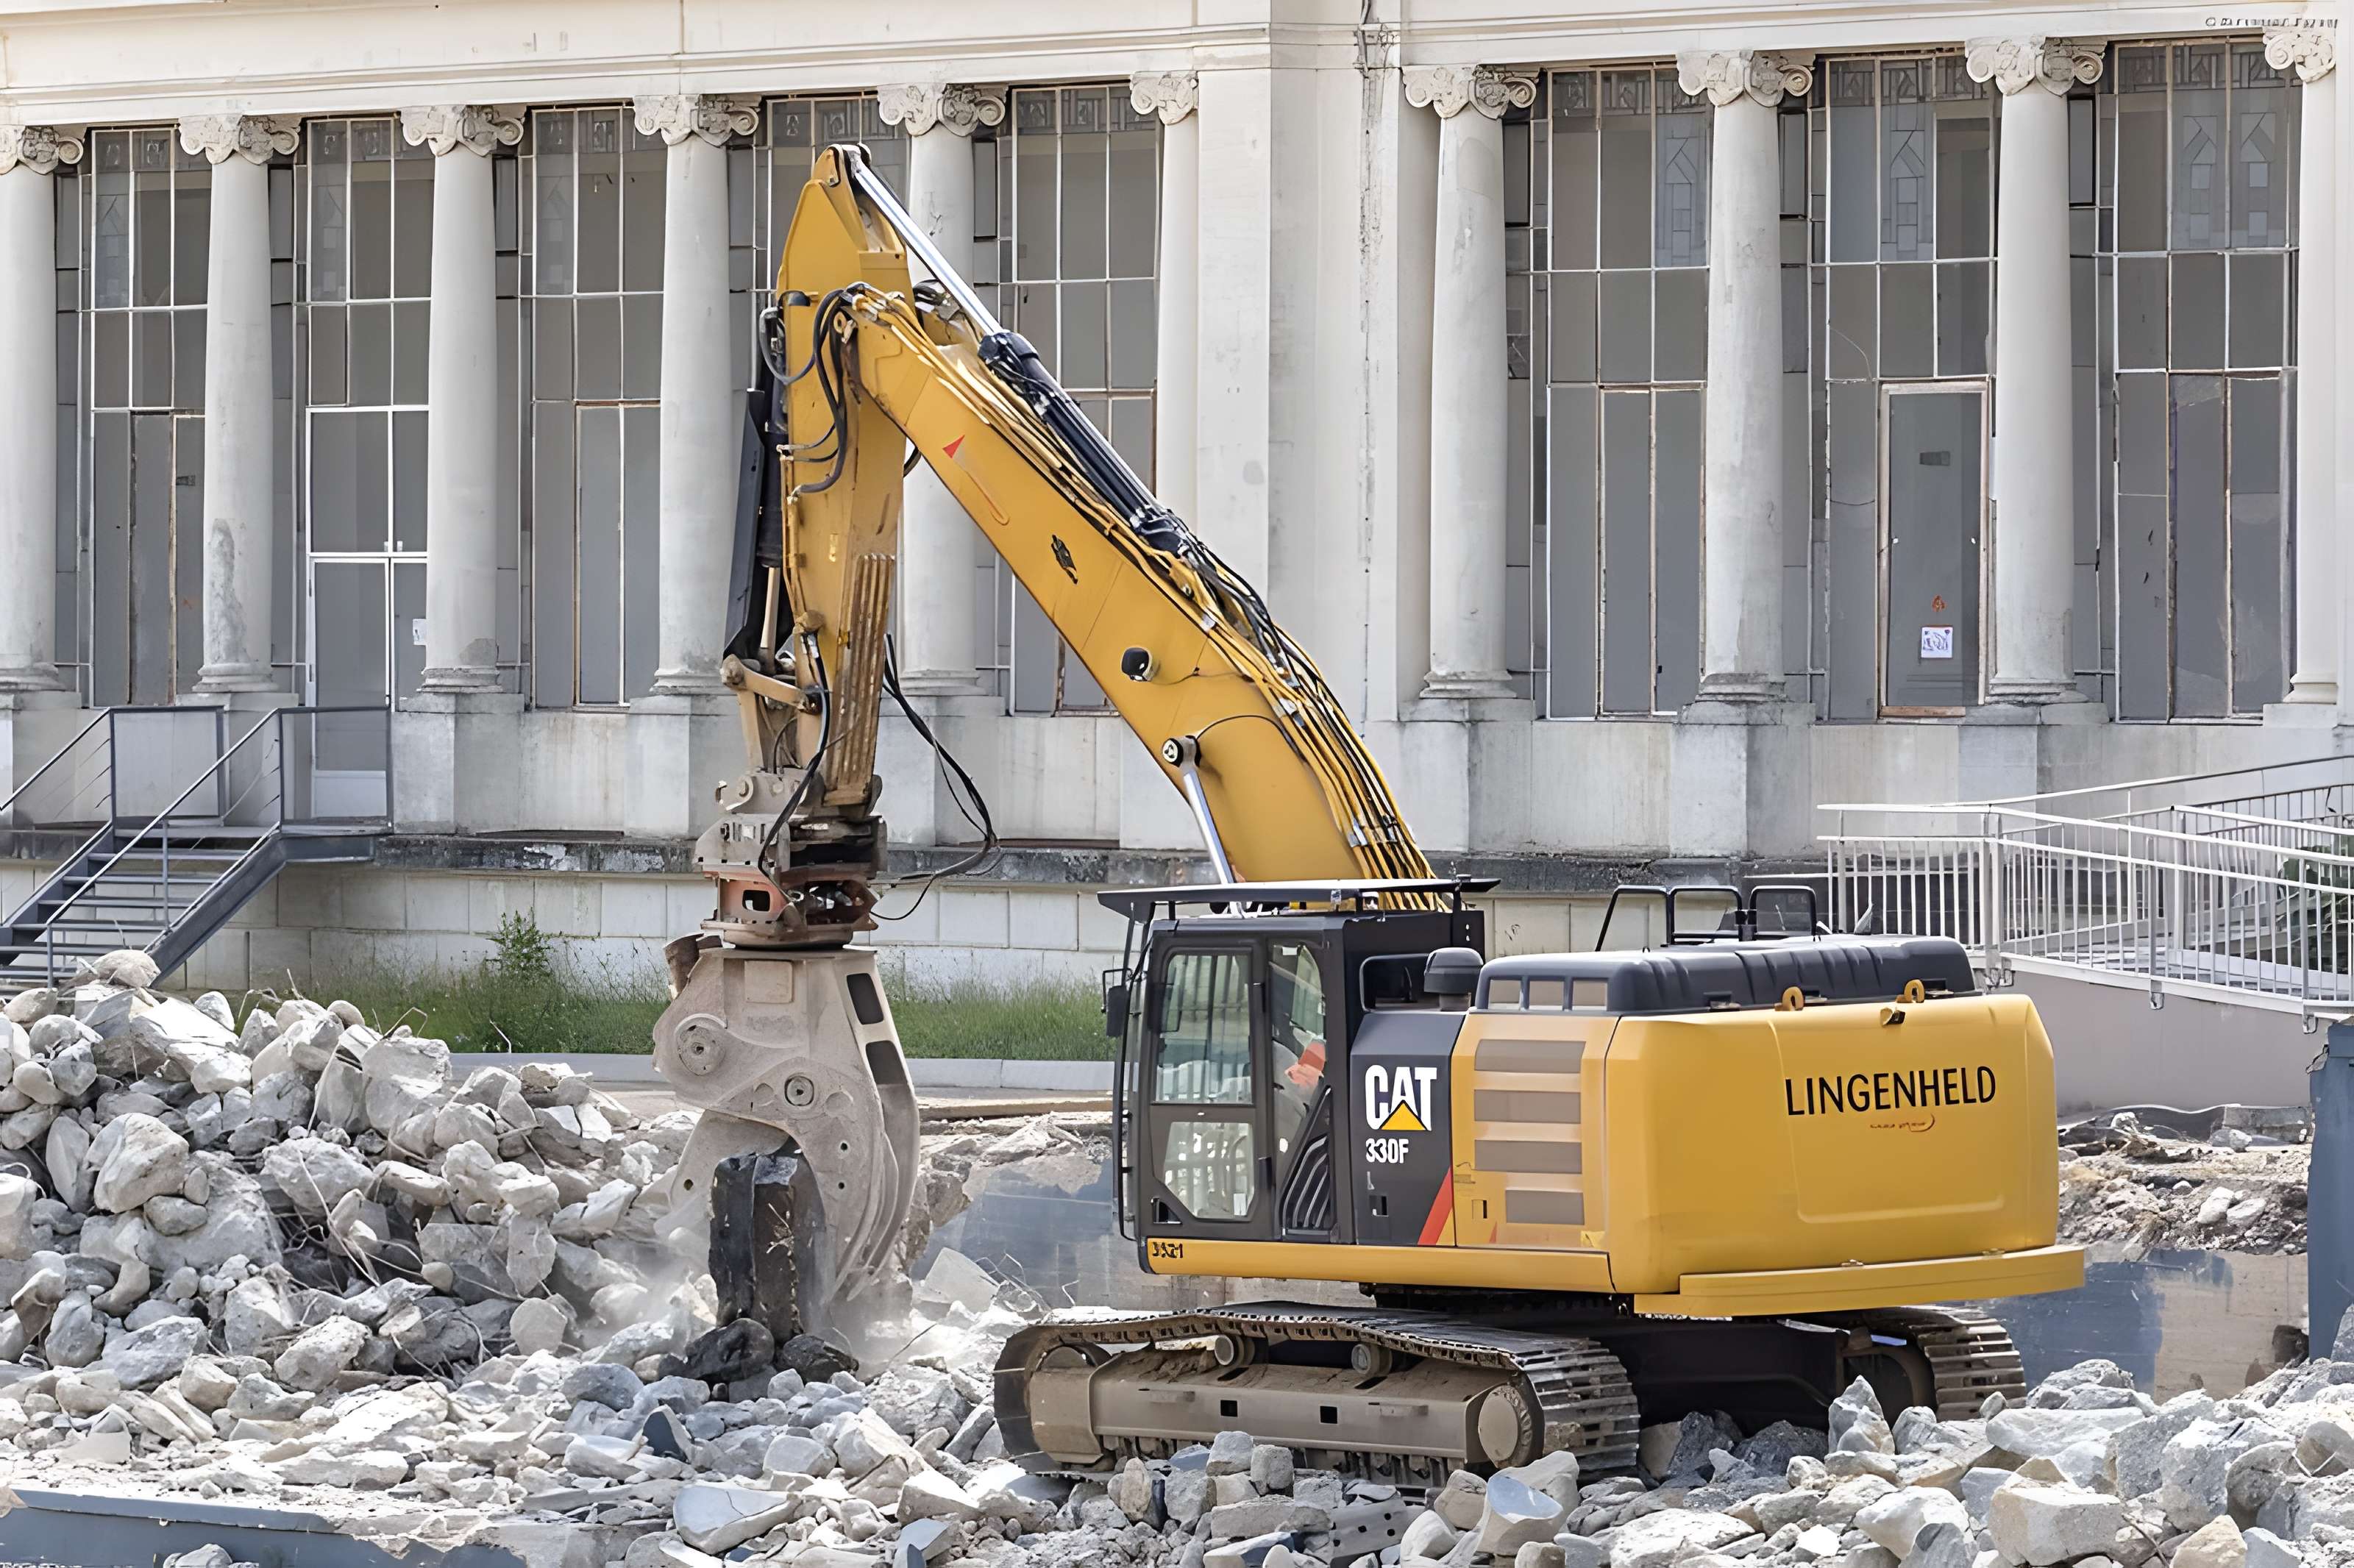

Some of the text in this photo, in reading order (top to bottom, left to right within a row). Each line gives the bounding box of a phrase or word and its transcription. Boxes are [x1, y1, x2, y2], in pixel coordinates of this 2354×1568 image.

[1365, 1064, 1437, 1131] CAT
[1785, 1066, 1996, 1116] LINGENHELD
[1365, 1138, 1409, 1163] 330F
